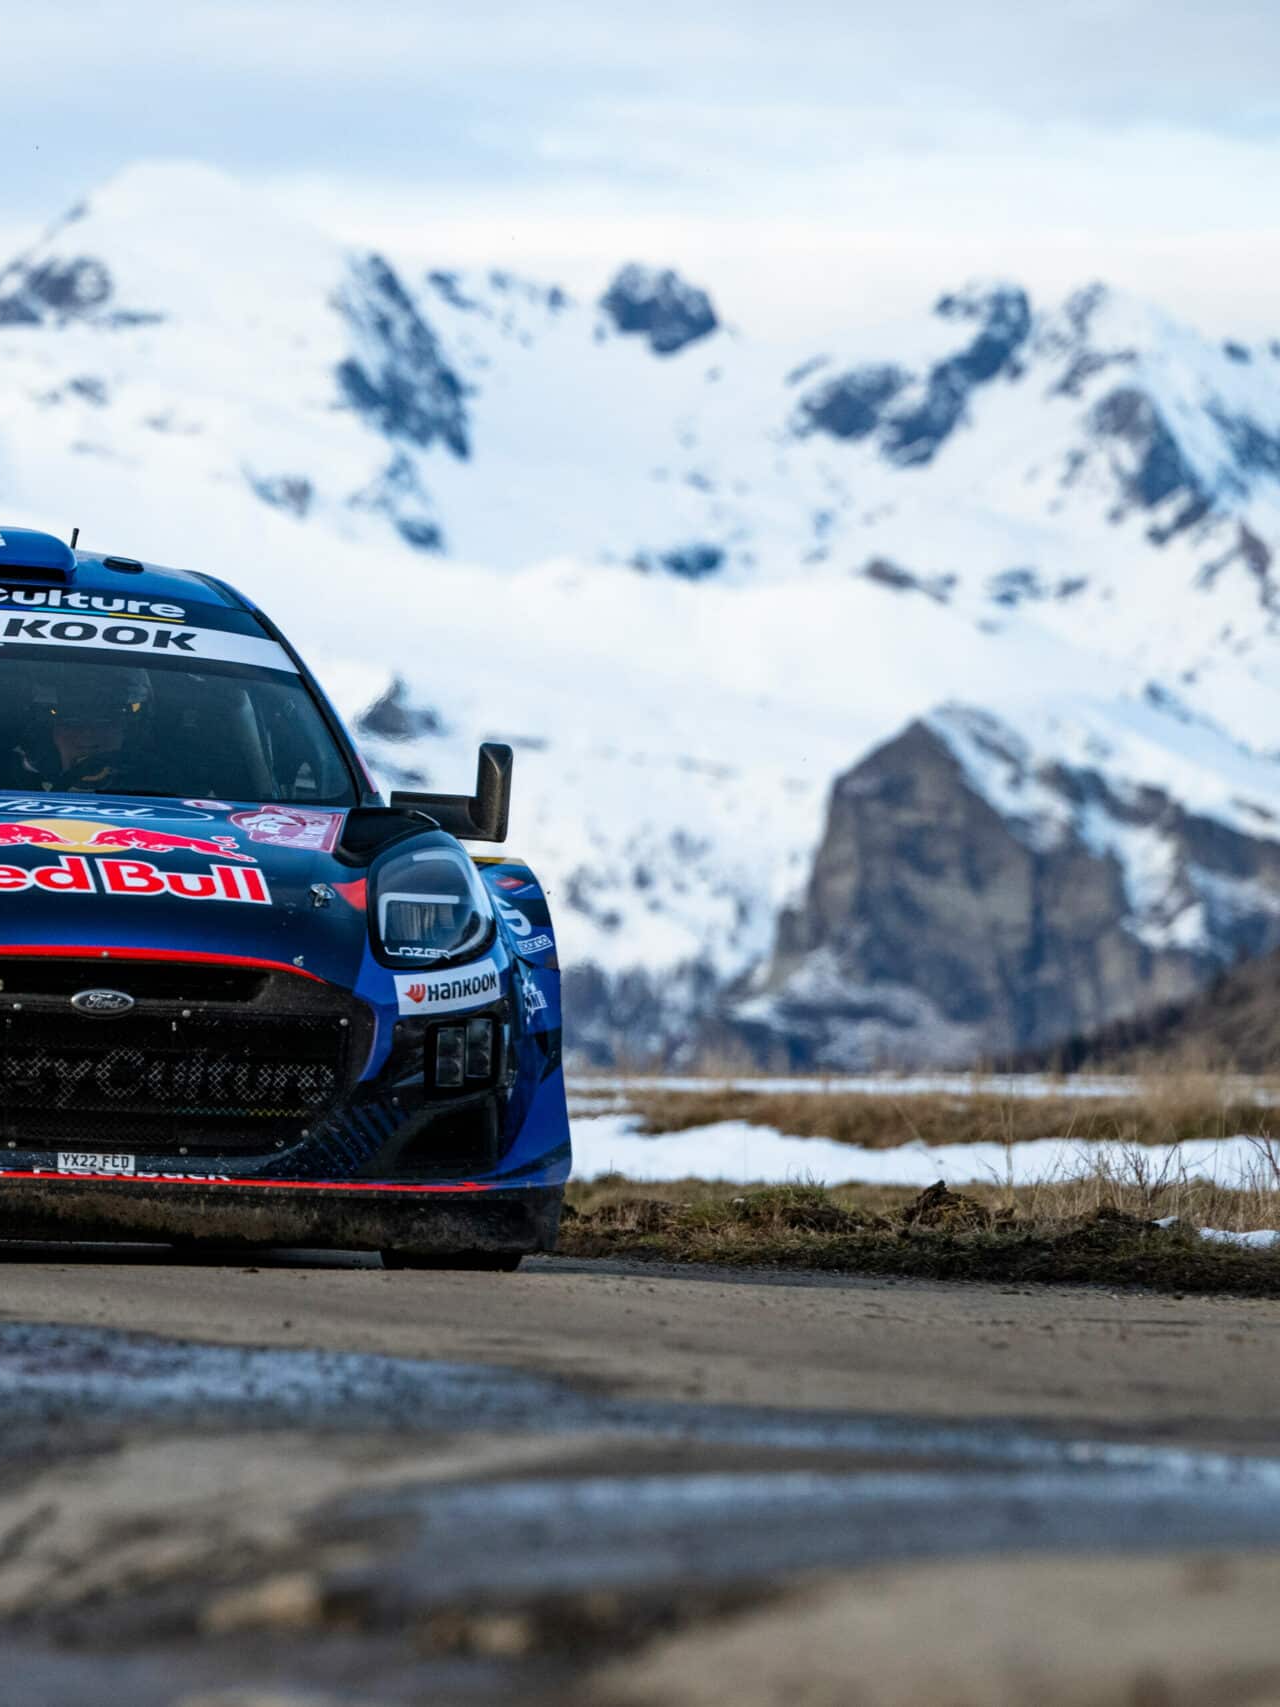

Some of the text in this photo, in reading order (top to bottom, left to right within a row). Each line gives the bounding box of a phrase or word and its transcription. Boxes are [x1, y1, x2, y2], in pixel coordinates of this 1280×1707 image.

[101, 859, 268, 903] Bull
[86, 993, 128, 1009] Ford
[62, 1153, 97, 1168] YX22
